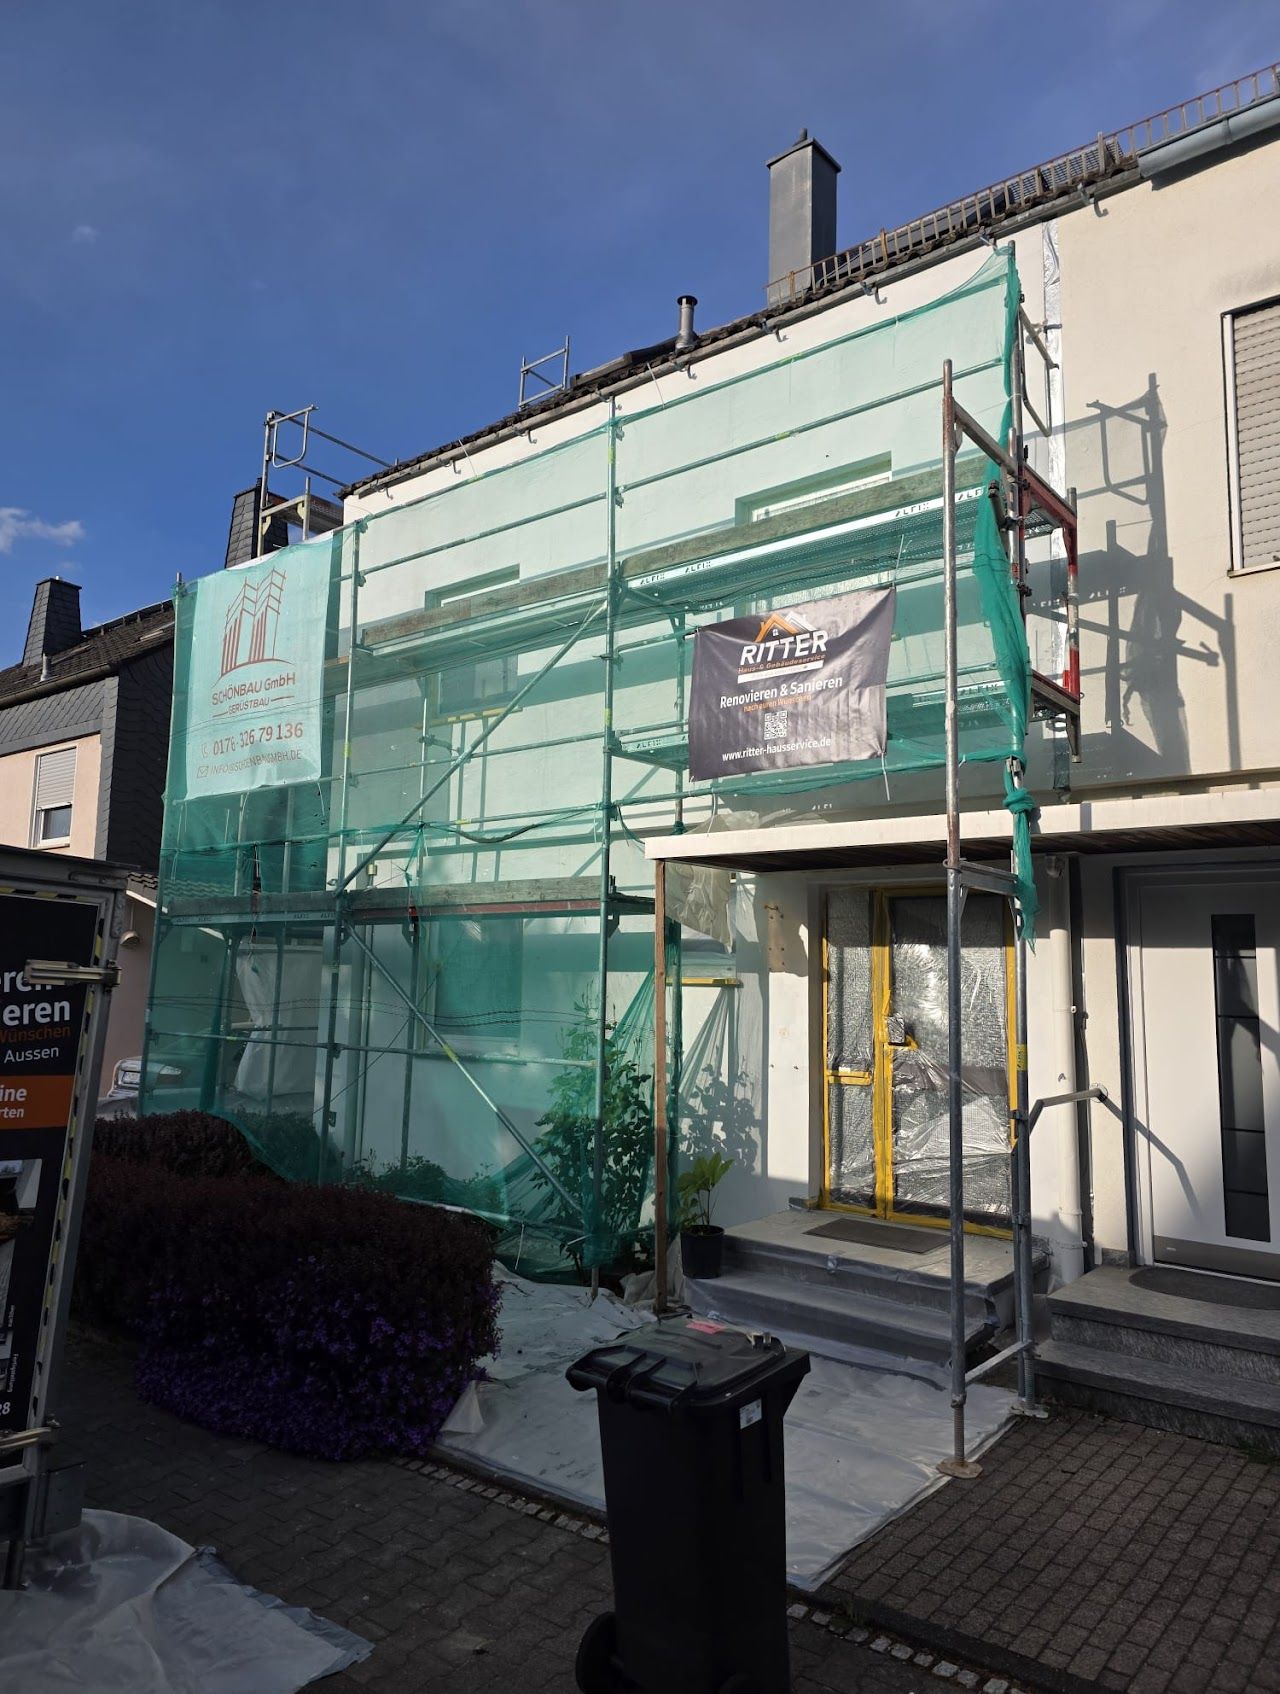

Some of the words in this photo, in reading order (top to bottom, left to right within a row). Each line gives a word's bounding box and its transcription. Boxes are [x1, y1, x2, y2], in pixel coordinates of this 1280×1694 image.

[740, 630, 828, 665] RITTER
[212, 681, 262, 705] SCHÖNBAU
[263, 672, 295, 691] GmbH
[719, 684, 778, 709] Renovieren
[780, 683, 789, 696] &
[789, 675, 843, 696] Sanieren
[258, 726, 274, 743] 79
[276, 722, 304, 740] 136
[722, 738, 831, 761] www.ritter-hausservice.de
[4, 1046, 60, 1065] Aussen
